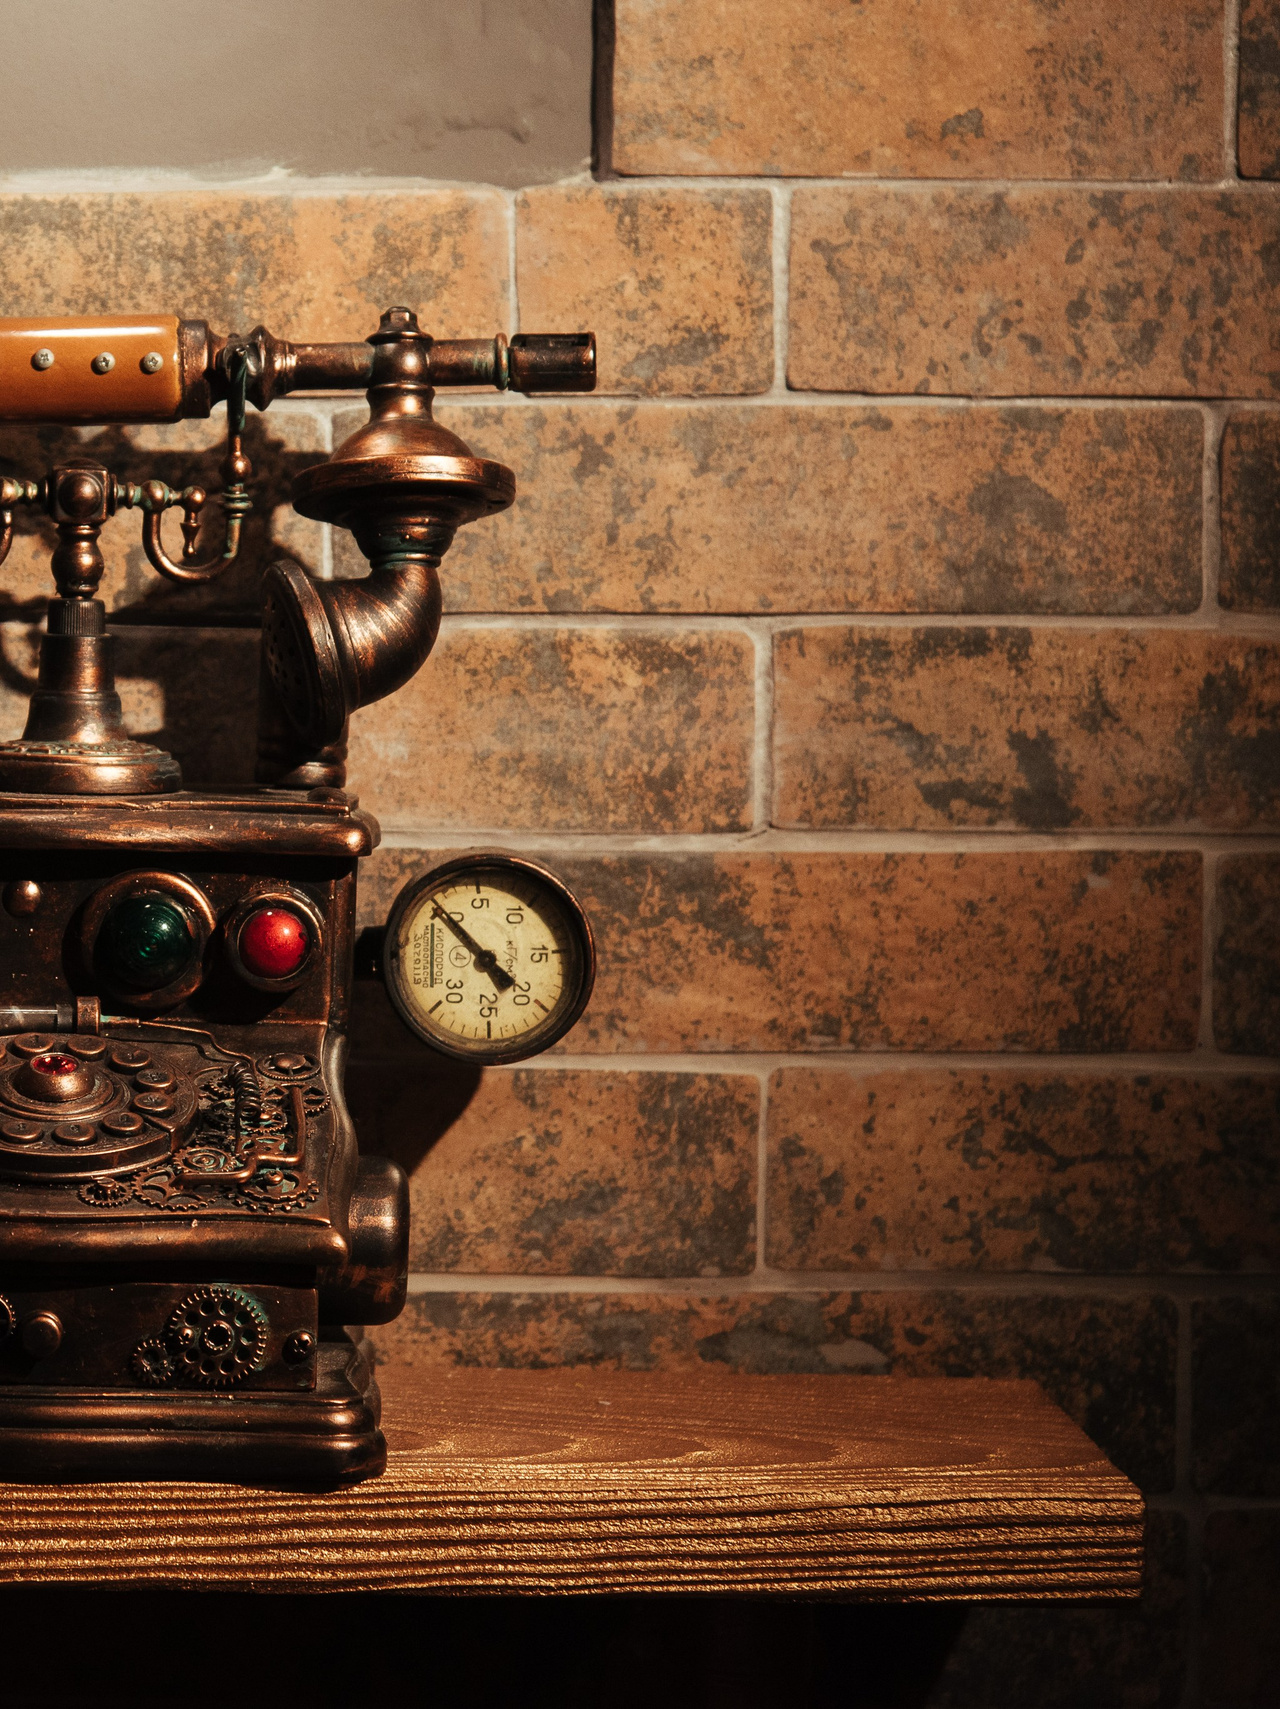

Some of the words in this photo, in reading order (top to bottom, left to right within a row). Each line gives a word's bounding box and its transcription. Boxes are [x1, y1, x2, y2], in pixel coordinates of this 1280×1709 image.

[471, 898, 489, 909] 5
[506, 905, 524, 924] 10
[435, 927, 444, 985] КИСЛОРОД
[454, 952, 467, 961] 4
[531, 944, 548, 963] 15
[445, 978, 464, 1004] 30
[513, 981, 531, 1006] 20
[479, 993, 498, 1018] 25
